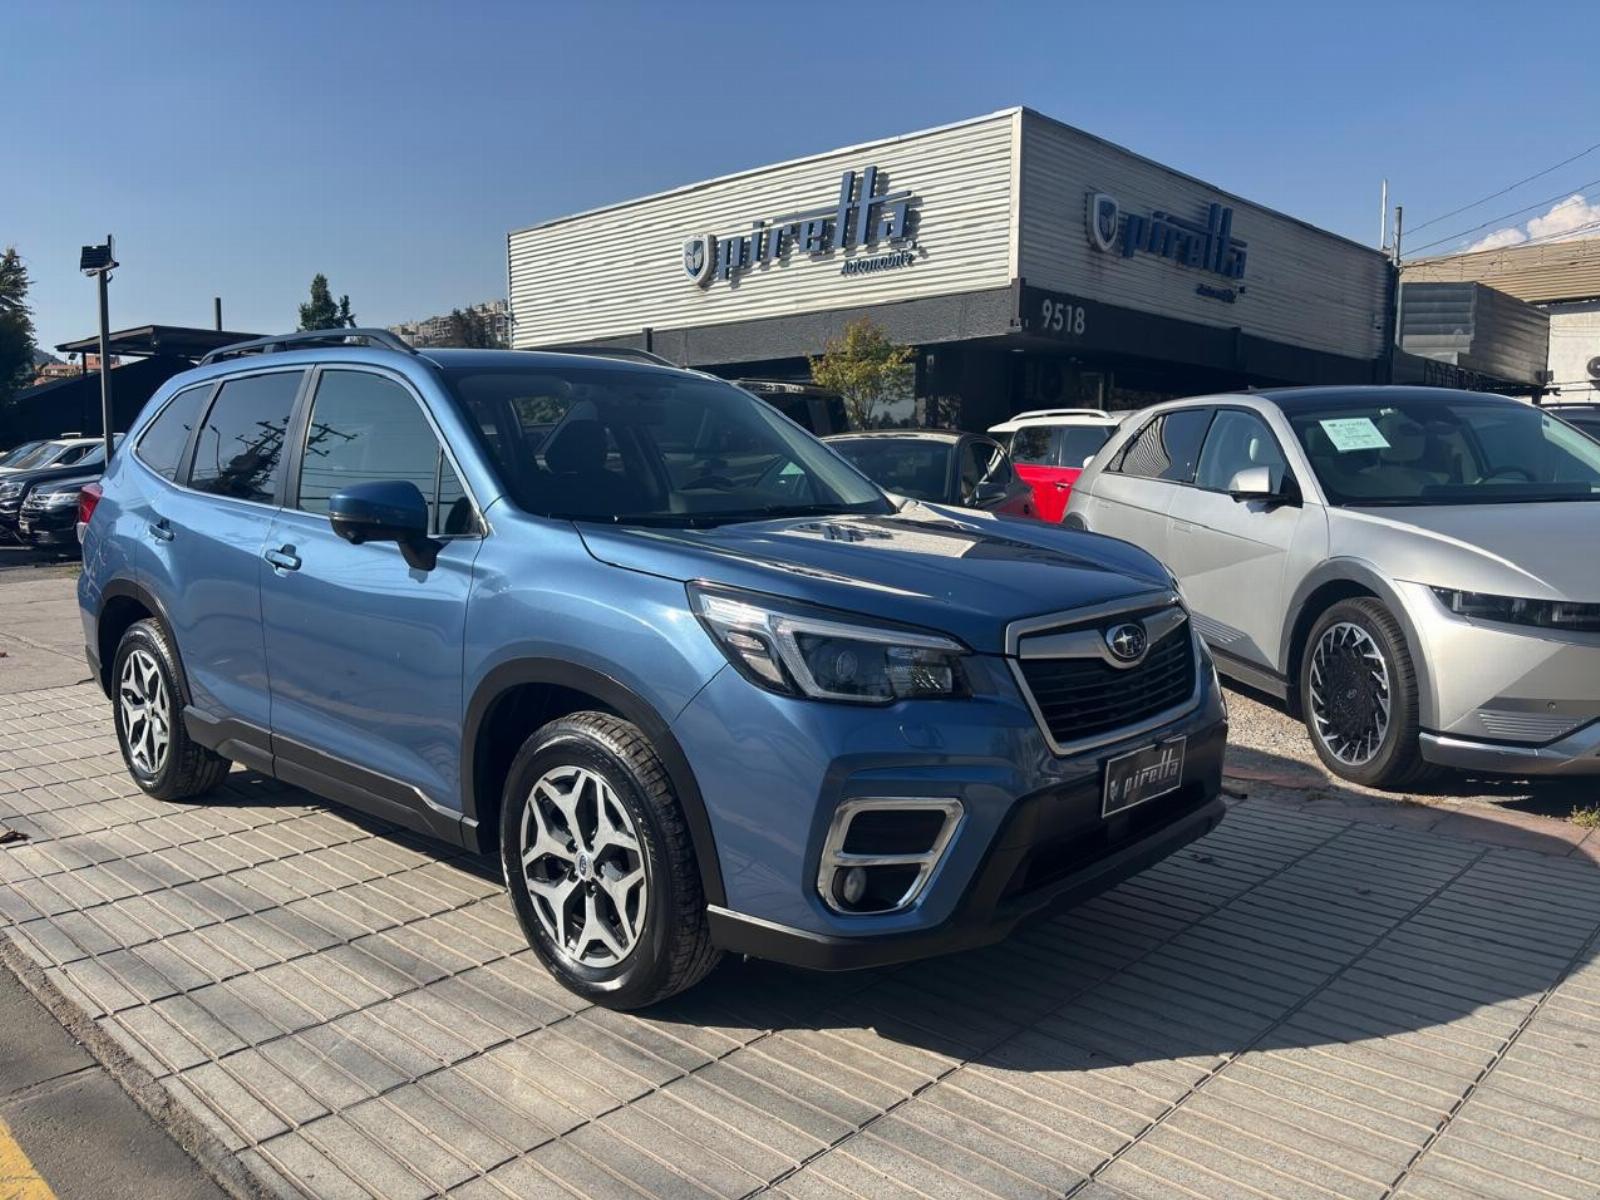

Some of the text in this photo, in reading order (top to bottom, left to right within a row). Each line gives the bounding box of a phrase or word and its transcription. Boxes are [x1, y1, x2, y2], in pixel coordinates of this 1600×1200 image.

[716, 165, 913, 280] piretta
[1042, 298, 1085, 335] 9518
[1123, 748, 1180, 799] piretta
